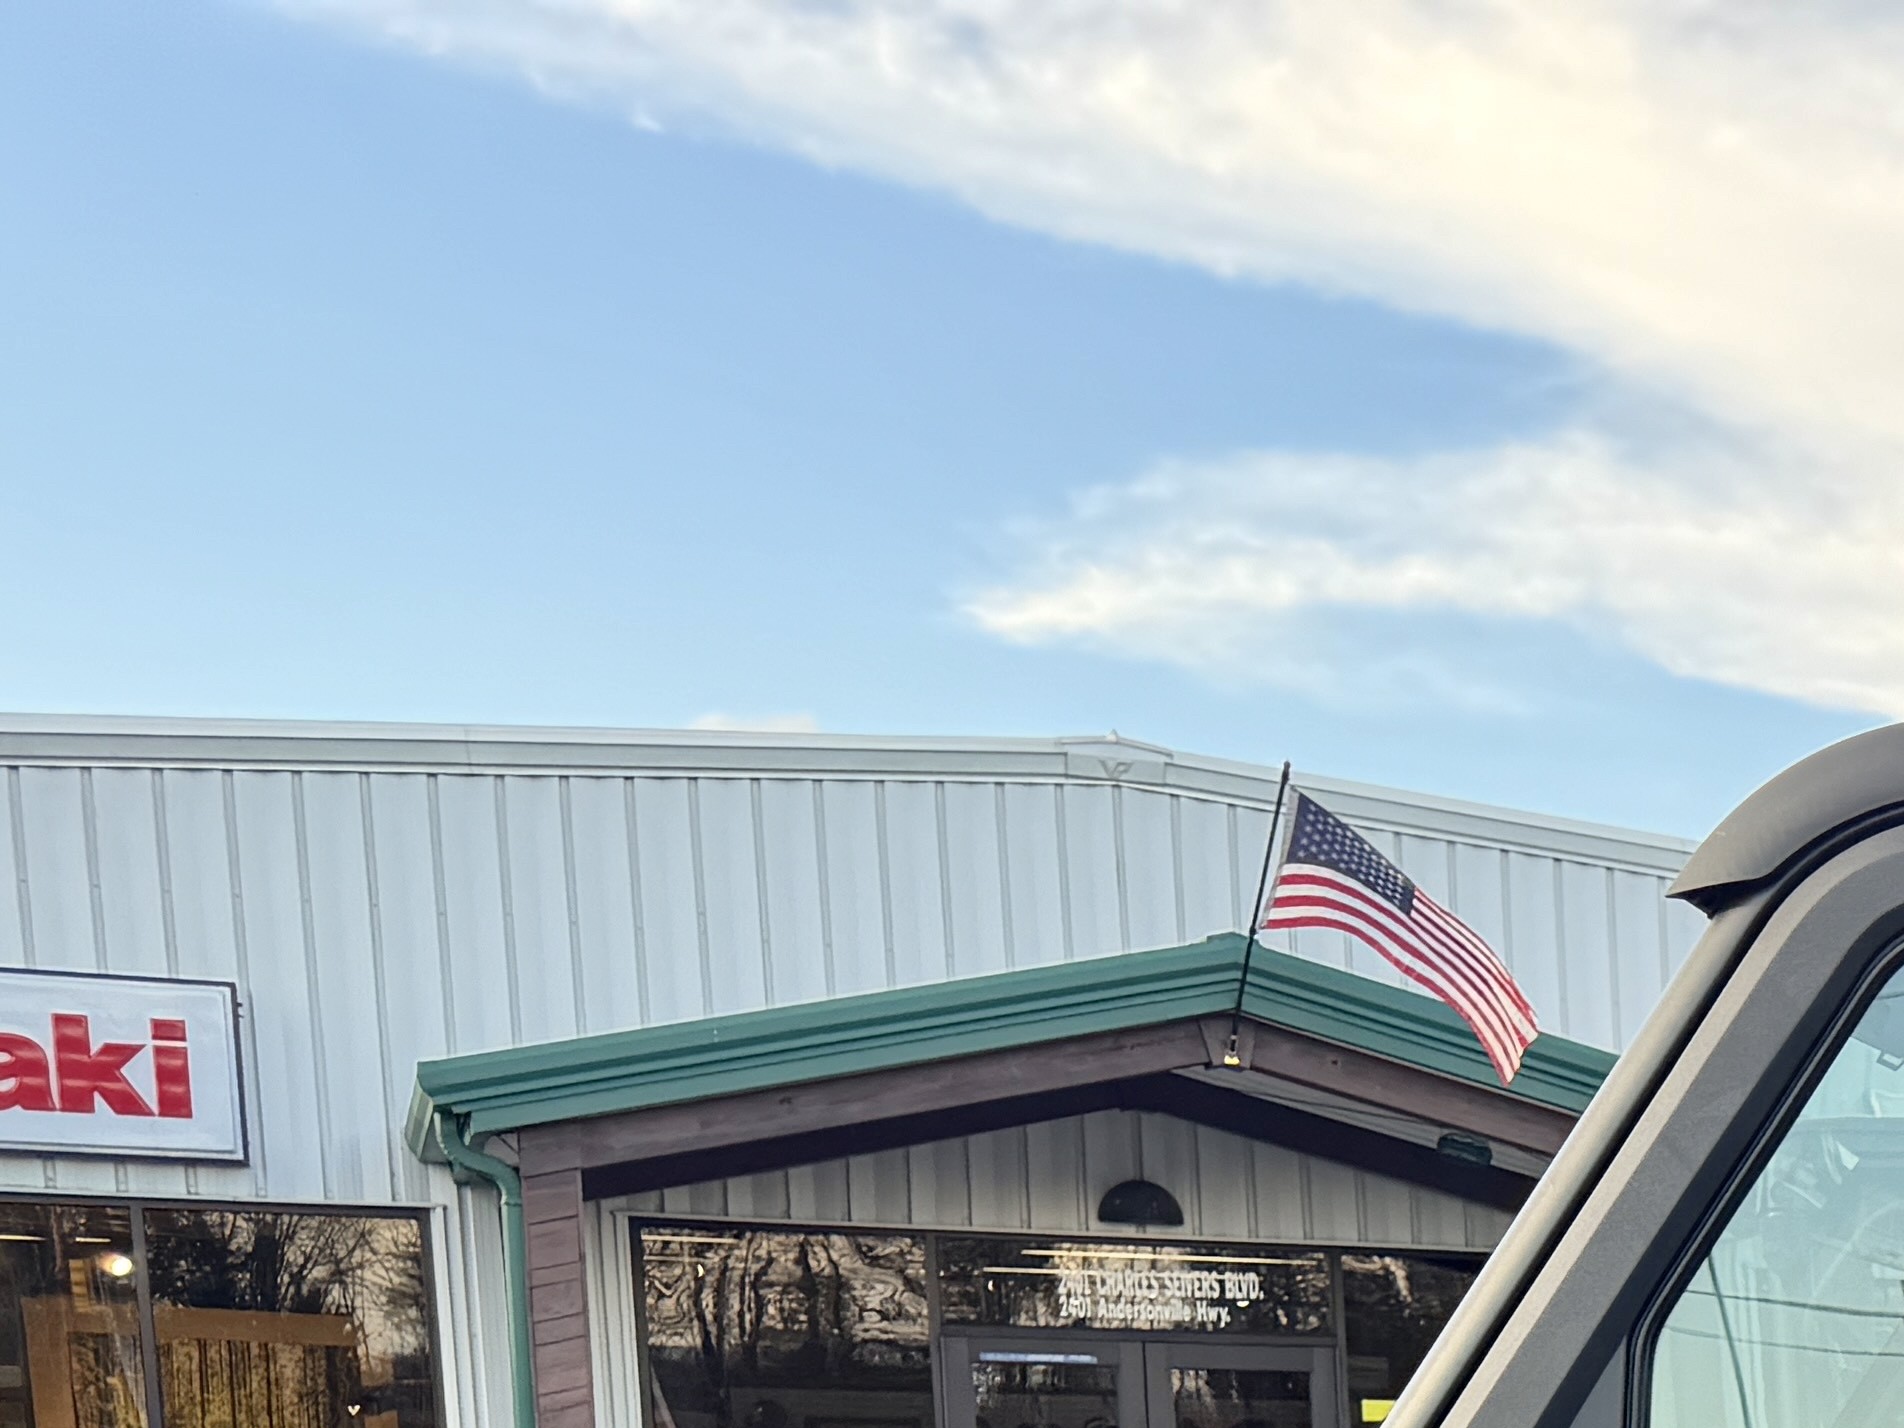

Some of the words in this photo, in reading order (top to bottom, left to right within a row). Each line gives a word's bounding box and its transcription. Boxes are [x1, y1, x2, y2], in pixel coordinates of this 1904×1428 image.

[1225, 1272, 1265, 1300] BLVD.
[1099, 1298, 1193, 1323] Andersonville
[1197, 1301, 1231, 1328] Hwy.
